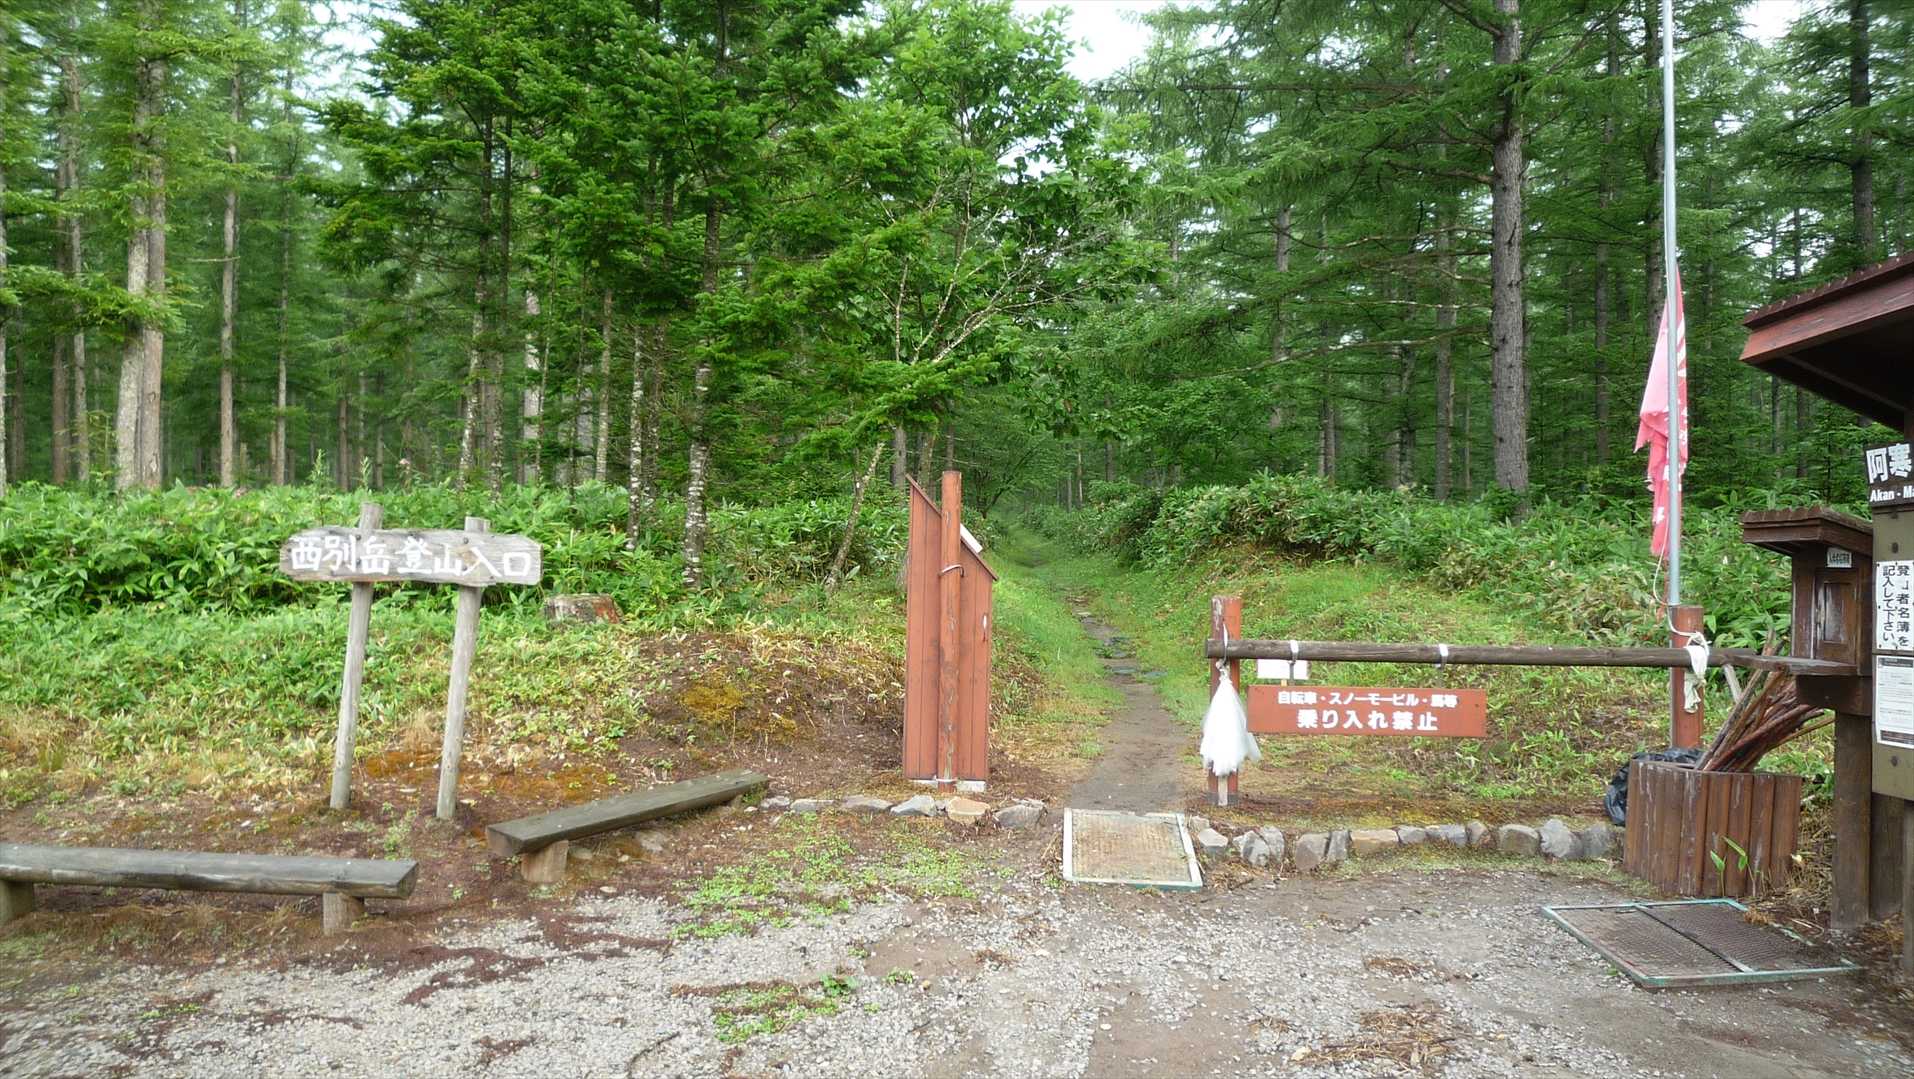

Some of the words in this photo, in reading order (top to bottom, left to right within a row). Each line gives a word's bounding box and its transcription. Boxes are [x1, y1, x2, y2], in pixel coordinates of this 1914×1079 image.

[1866, 443, 1912, 484] 阿寒
[1870, 489, 1895, 502] Akan
[290, 535, 533, 577] 西別岳登山入口
[1297, 709, 1438, 731] 乗り入れ禁止
